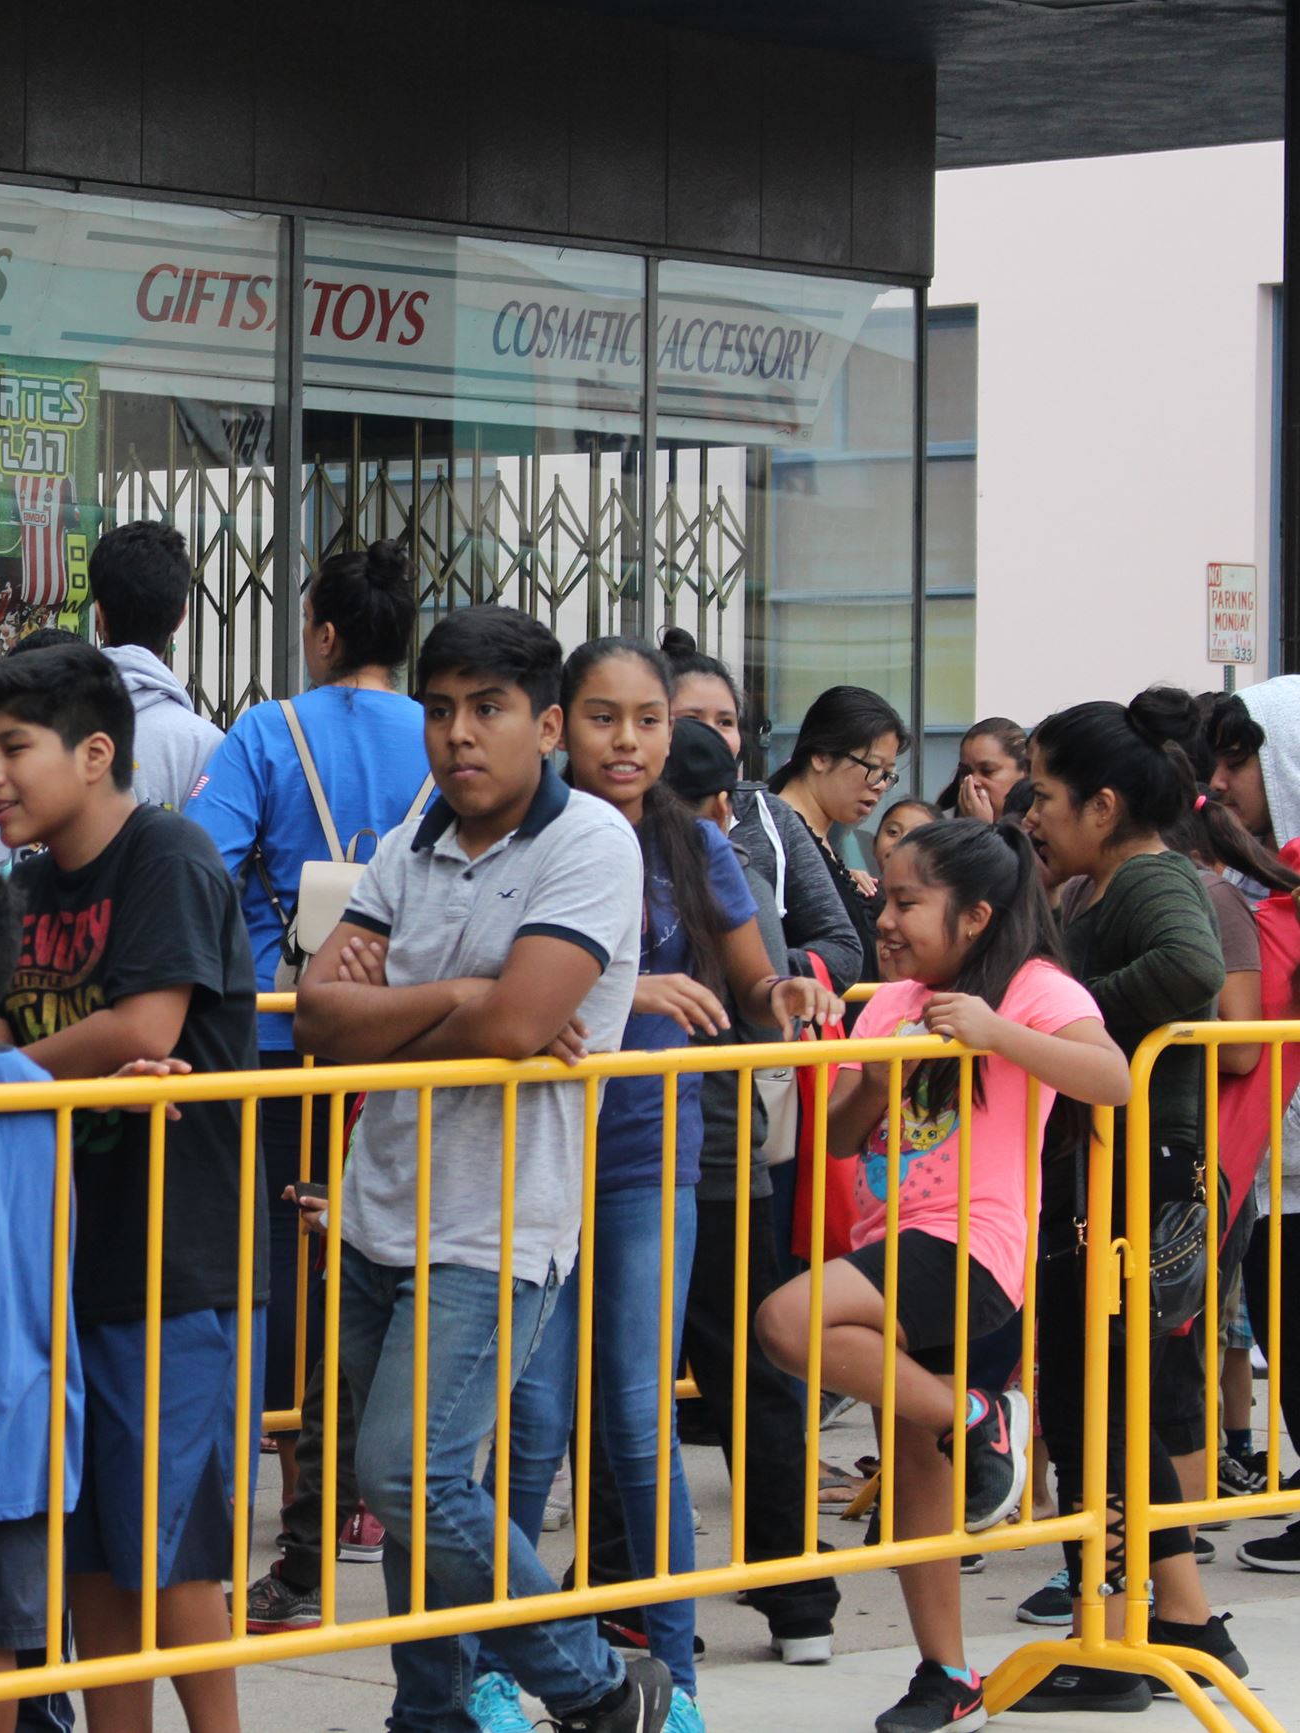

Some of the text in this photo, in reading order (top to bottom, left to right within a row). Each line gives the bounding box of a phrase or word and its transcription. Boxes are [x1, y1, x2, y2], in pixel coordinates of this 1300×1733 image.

[23, 512, 46, 523] BIMBO
[1209, 565, 1221, 584] NO
[1212, 591, 1253, 610] PARKING
[1215, 613, 1250, 631] MONDAY
[1235, 647, 1253, 662] 333
